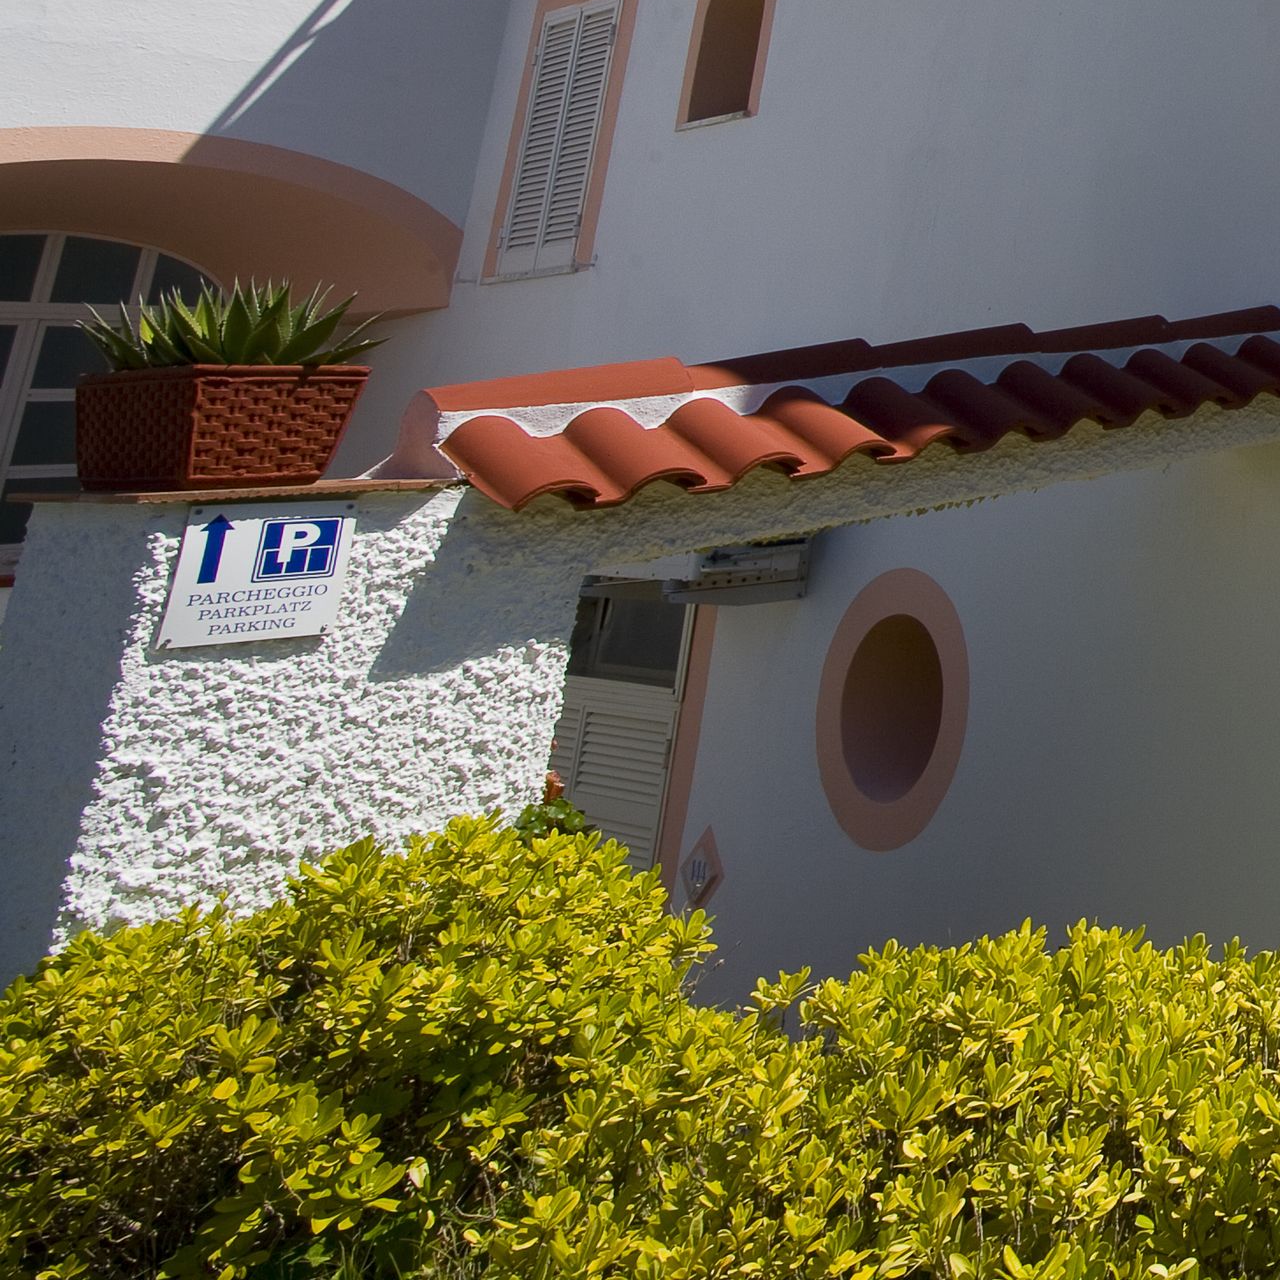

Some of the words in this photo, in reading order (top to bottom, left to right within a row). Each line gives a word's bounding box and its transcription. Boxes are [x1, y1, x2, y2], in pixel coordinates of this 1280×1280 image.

[186, 583, 328, 607] PARCHEGGIO
[197, 600, 312, 621] PARKPLATZ
[207, 617, 296, 636] PARKING
